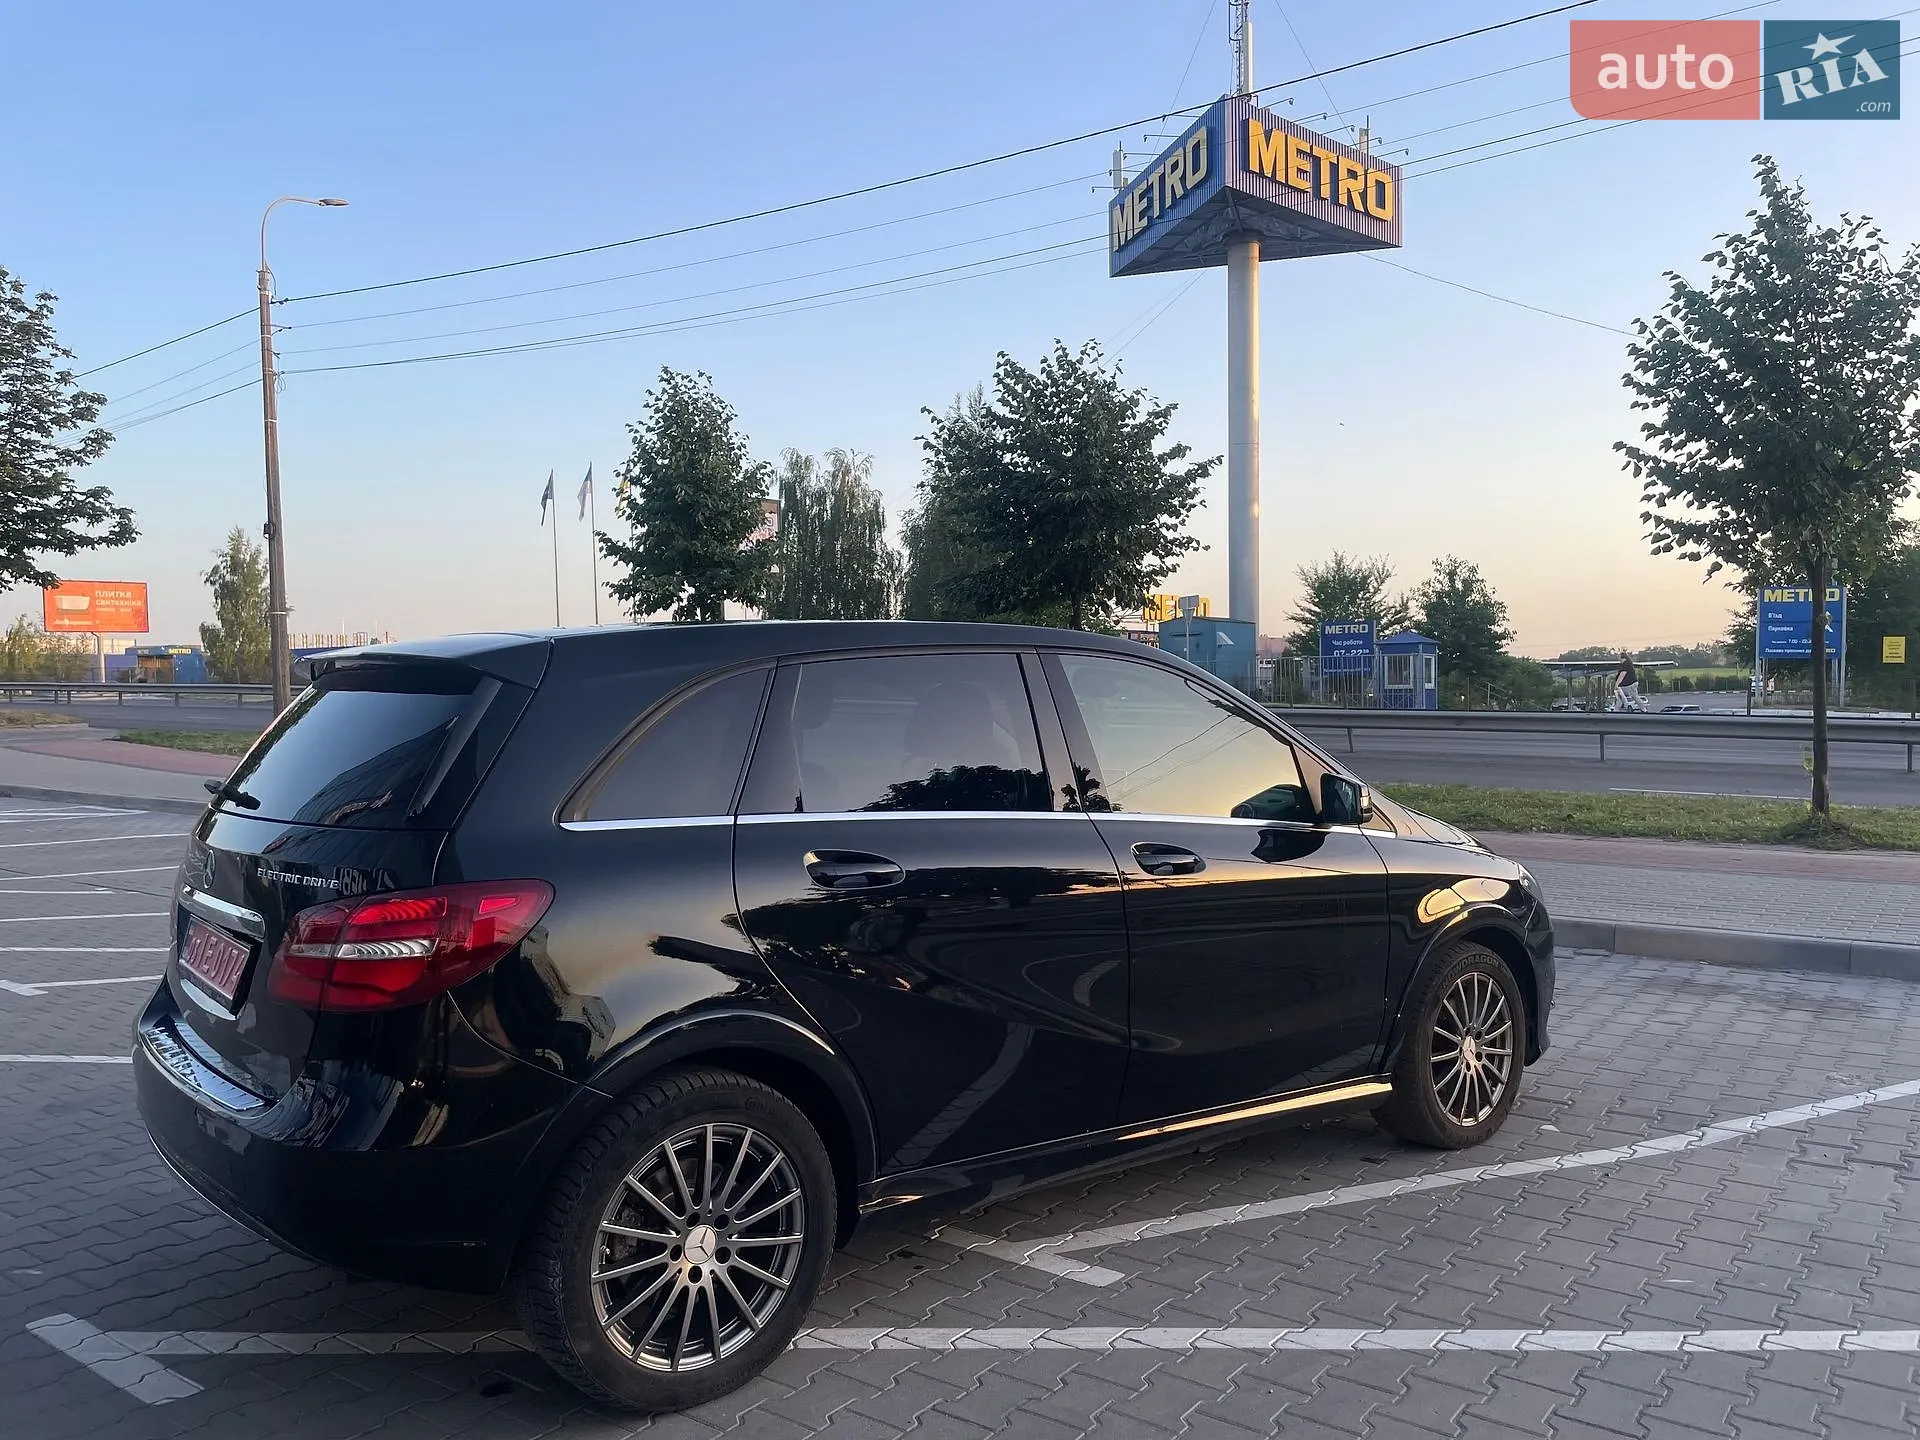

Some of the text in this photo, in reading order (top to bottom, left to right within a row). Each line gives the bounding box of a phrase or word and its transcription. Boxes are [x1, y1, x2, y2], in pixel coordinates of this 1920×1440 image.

[1112, 125, 1208, 251] METRO
[1248, 118, 1393, 222] METRO
[1325, 624, 1369, 634] METRO
[257, 868, 339, 889] ELECTRIC DRIVE
